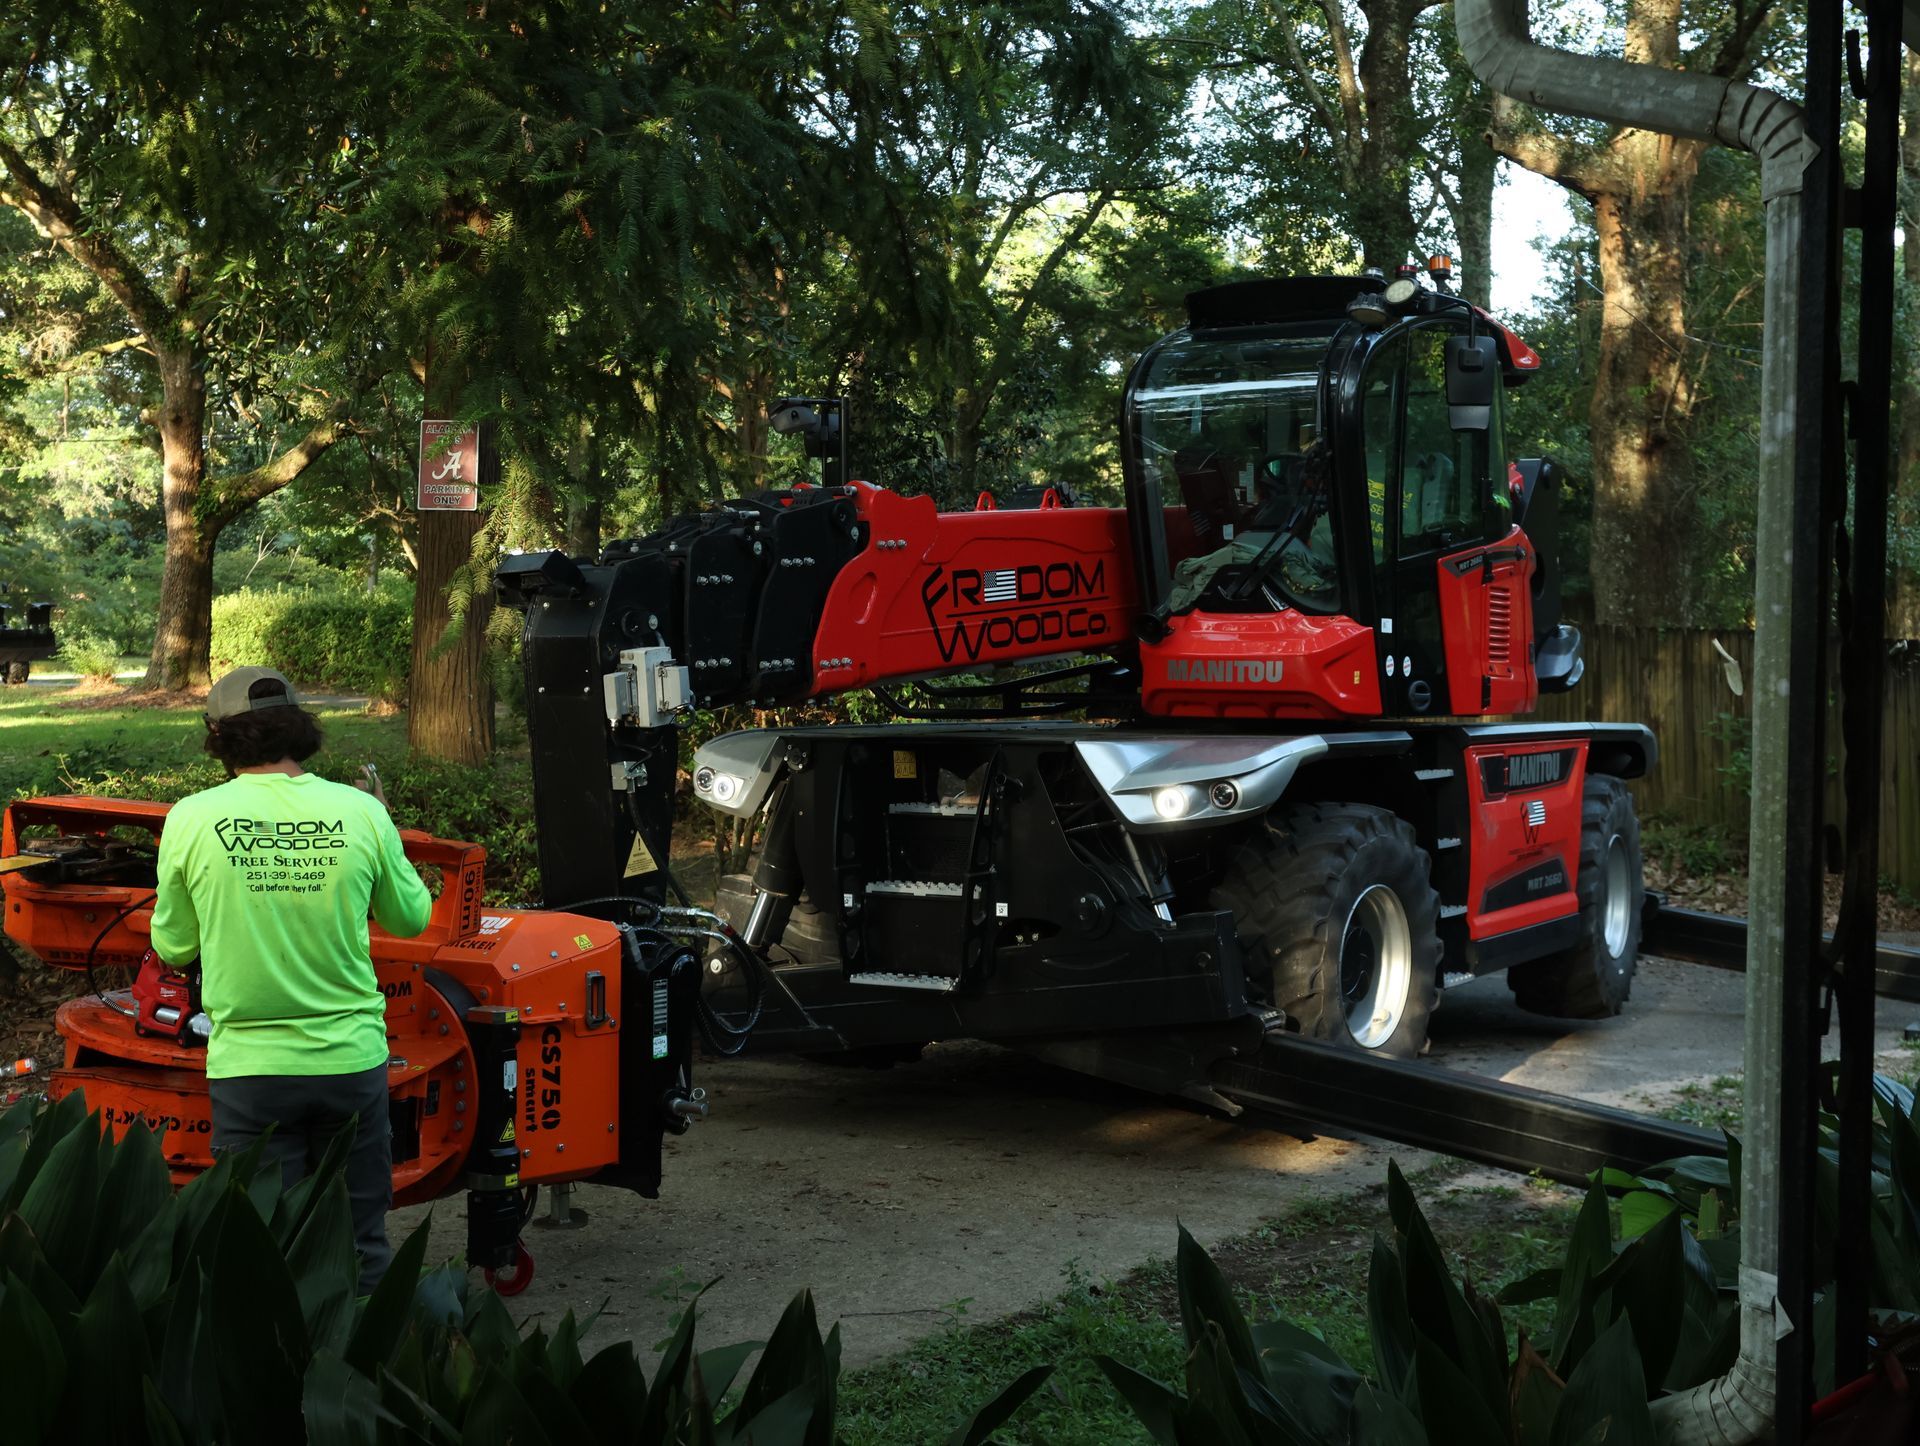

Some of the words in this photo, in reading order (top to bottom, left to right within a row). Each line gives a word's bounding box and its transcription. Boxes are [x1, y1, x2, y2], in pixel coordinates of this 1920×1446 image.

[424, 485, 472, 494] PARKING
[433, 496, 461, 505] ONLY
[1167, 659, 1284, 683] MANITOU
[1509, 752, 1561, 787] MANITOU
[266, 884, 290, 892] before
[541, 1025, 561, 1130] CS750
[525, 1067, 538, 1132] smart
